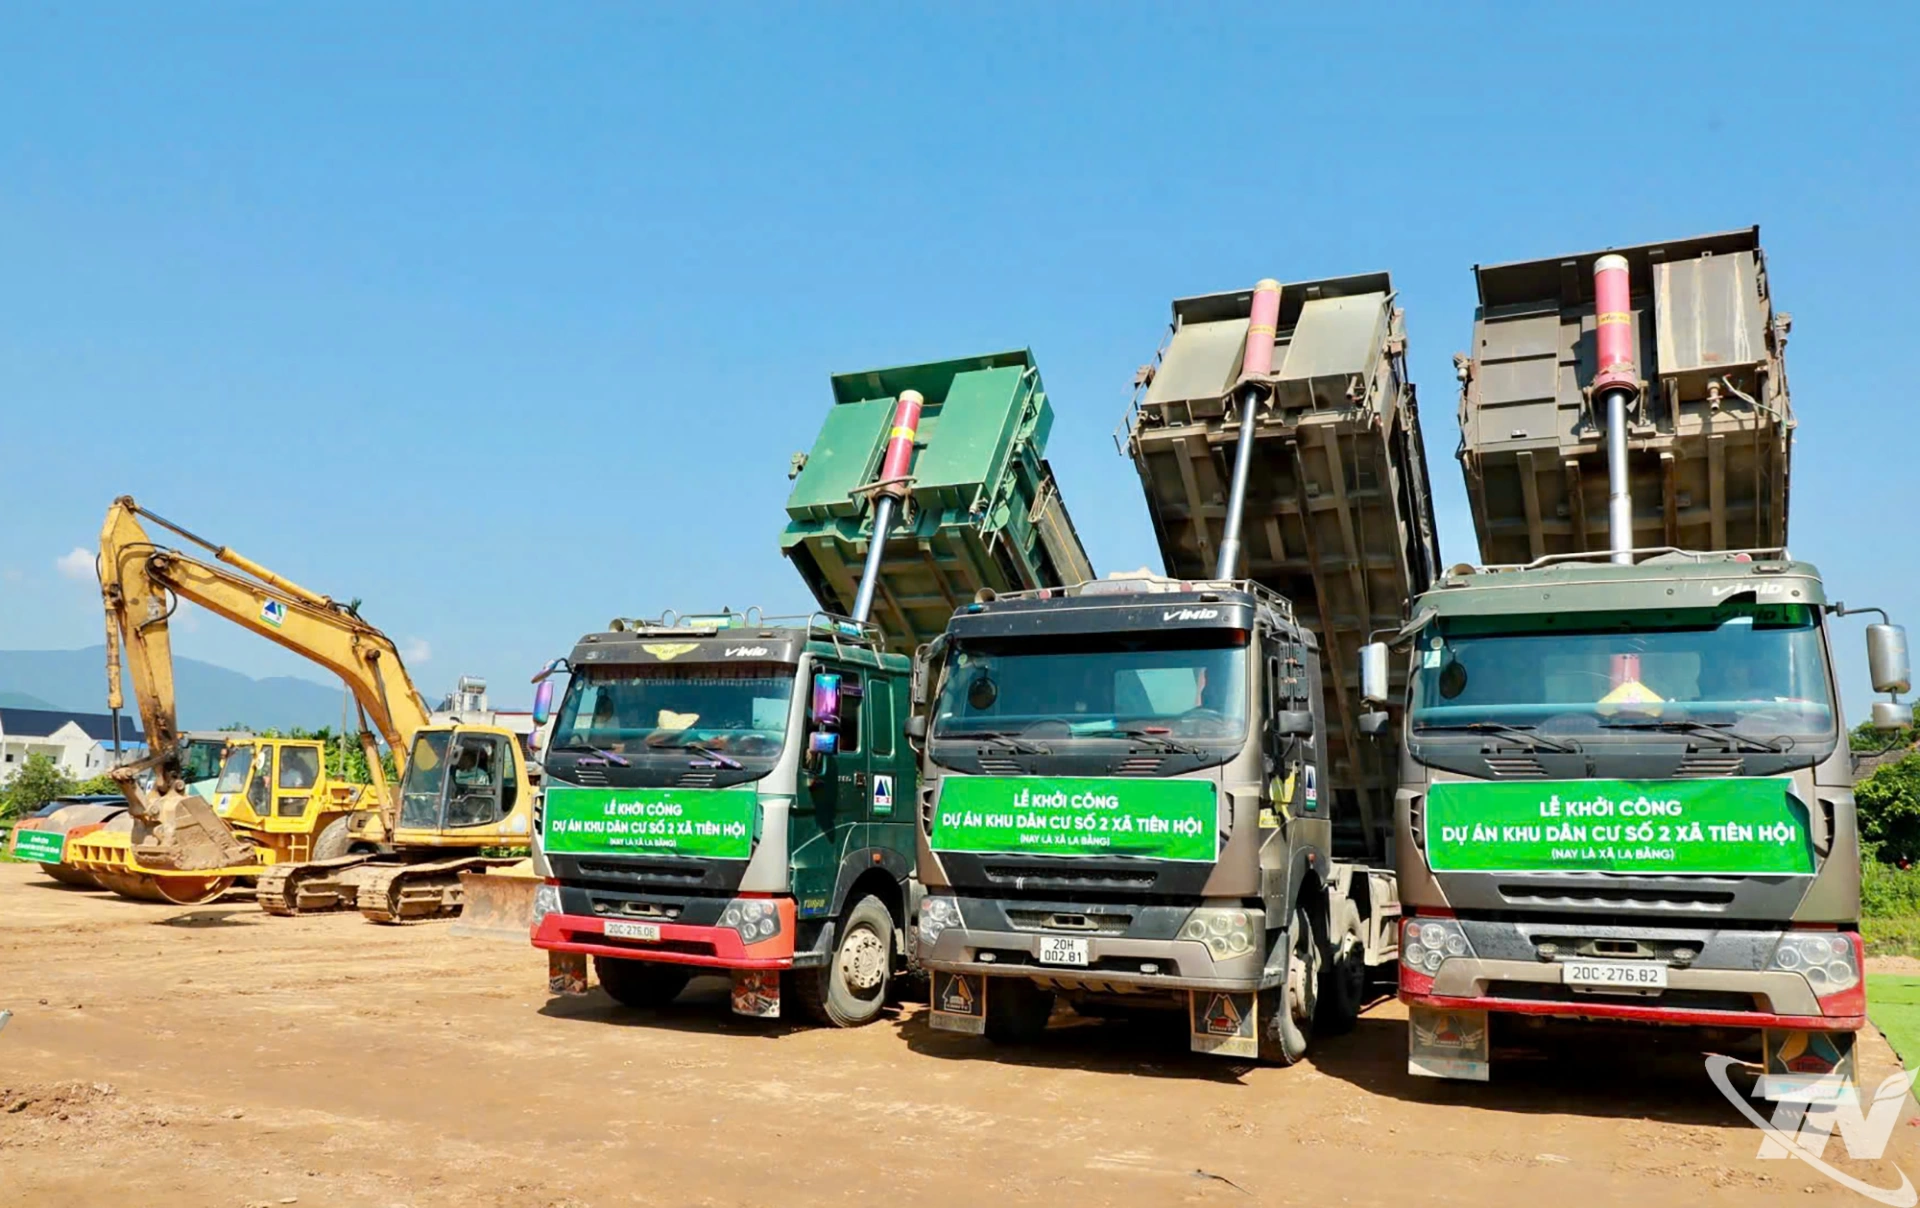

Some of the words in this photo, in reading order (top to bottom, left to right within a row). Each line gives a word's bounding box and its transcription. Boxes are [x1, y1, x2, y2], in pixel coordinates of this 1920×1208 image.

[1014, 789, 1029, 807] LỄ
[1032, 791, 1067, 808] KHỞI
[1071, 792, 1118, 809] CÔNG
[1540, 795, 1560, 816] LỄ
[1566, 796, 1613, 816] KHỞI
[1619, 797, 1682, 816] CÔNG
[618, 802, 644, 815] KHỞI
[647, 802, 682, 816] CÔNG
[553, 820, 566, 833] DỰ
[568, 820, 582, 831] ÁN
[584, 822, 604, 832] KHU
[606, 820, 628, 833] DÂN
[631, 822, 648, 833] CƯ
[649, 819, 665, 834] SỐ
[668, 823, 674, 834] 2
[677, 820, 692, 834] XÃ
[696, 821, 720, 835] TIÊN
[723, 822, 745, 838] HỘI
[943, 813, 961, 828] DỰ
[963, 811, 982, 826] ÁN
[986, 815, 1013, 827] KHU
[1017, 812, 1046, 828] DÂN
[1050, 816, 1071, 829] CƯ
[1075, 813, 1096, 830] SỐ
[1100, 817, 1108, 830] 2
[1112, 815, 1132, 831] XÃ
[1137, 816, 1169, 832] TIÊN
[1173, 817, 1202, 837] HỘI
[1443, 826, 1468, 845] DỰ
[1472, 823, 1497, 841] ÁN
[1503, 827, 1540, 842] KHU
[1548, 823, 1586, 841] DÂN
[1592, 825, 1621, 841] CƯ
[1625, 821, 1654, 841] SỐ
[1659, 826, 1670, 841] 2
[1676, 822, 1704, 841] XÃ
[1708, 823, 1751, 841] TIÊN
[1759, 822, 1795, 846] HỘI
[1552, 849, 1577, 859] (NAY
[1582, 848, 1596, 858] LÀ
[1600, 847, 1615, 858] XÃ
[1618, 850, 1632, 859] LA
[1053, 938, 1074, 950] 20H
[1044, 950, 1082, 962] 002.81
[1573, 966, 1658, 982] 20C-276.82
